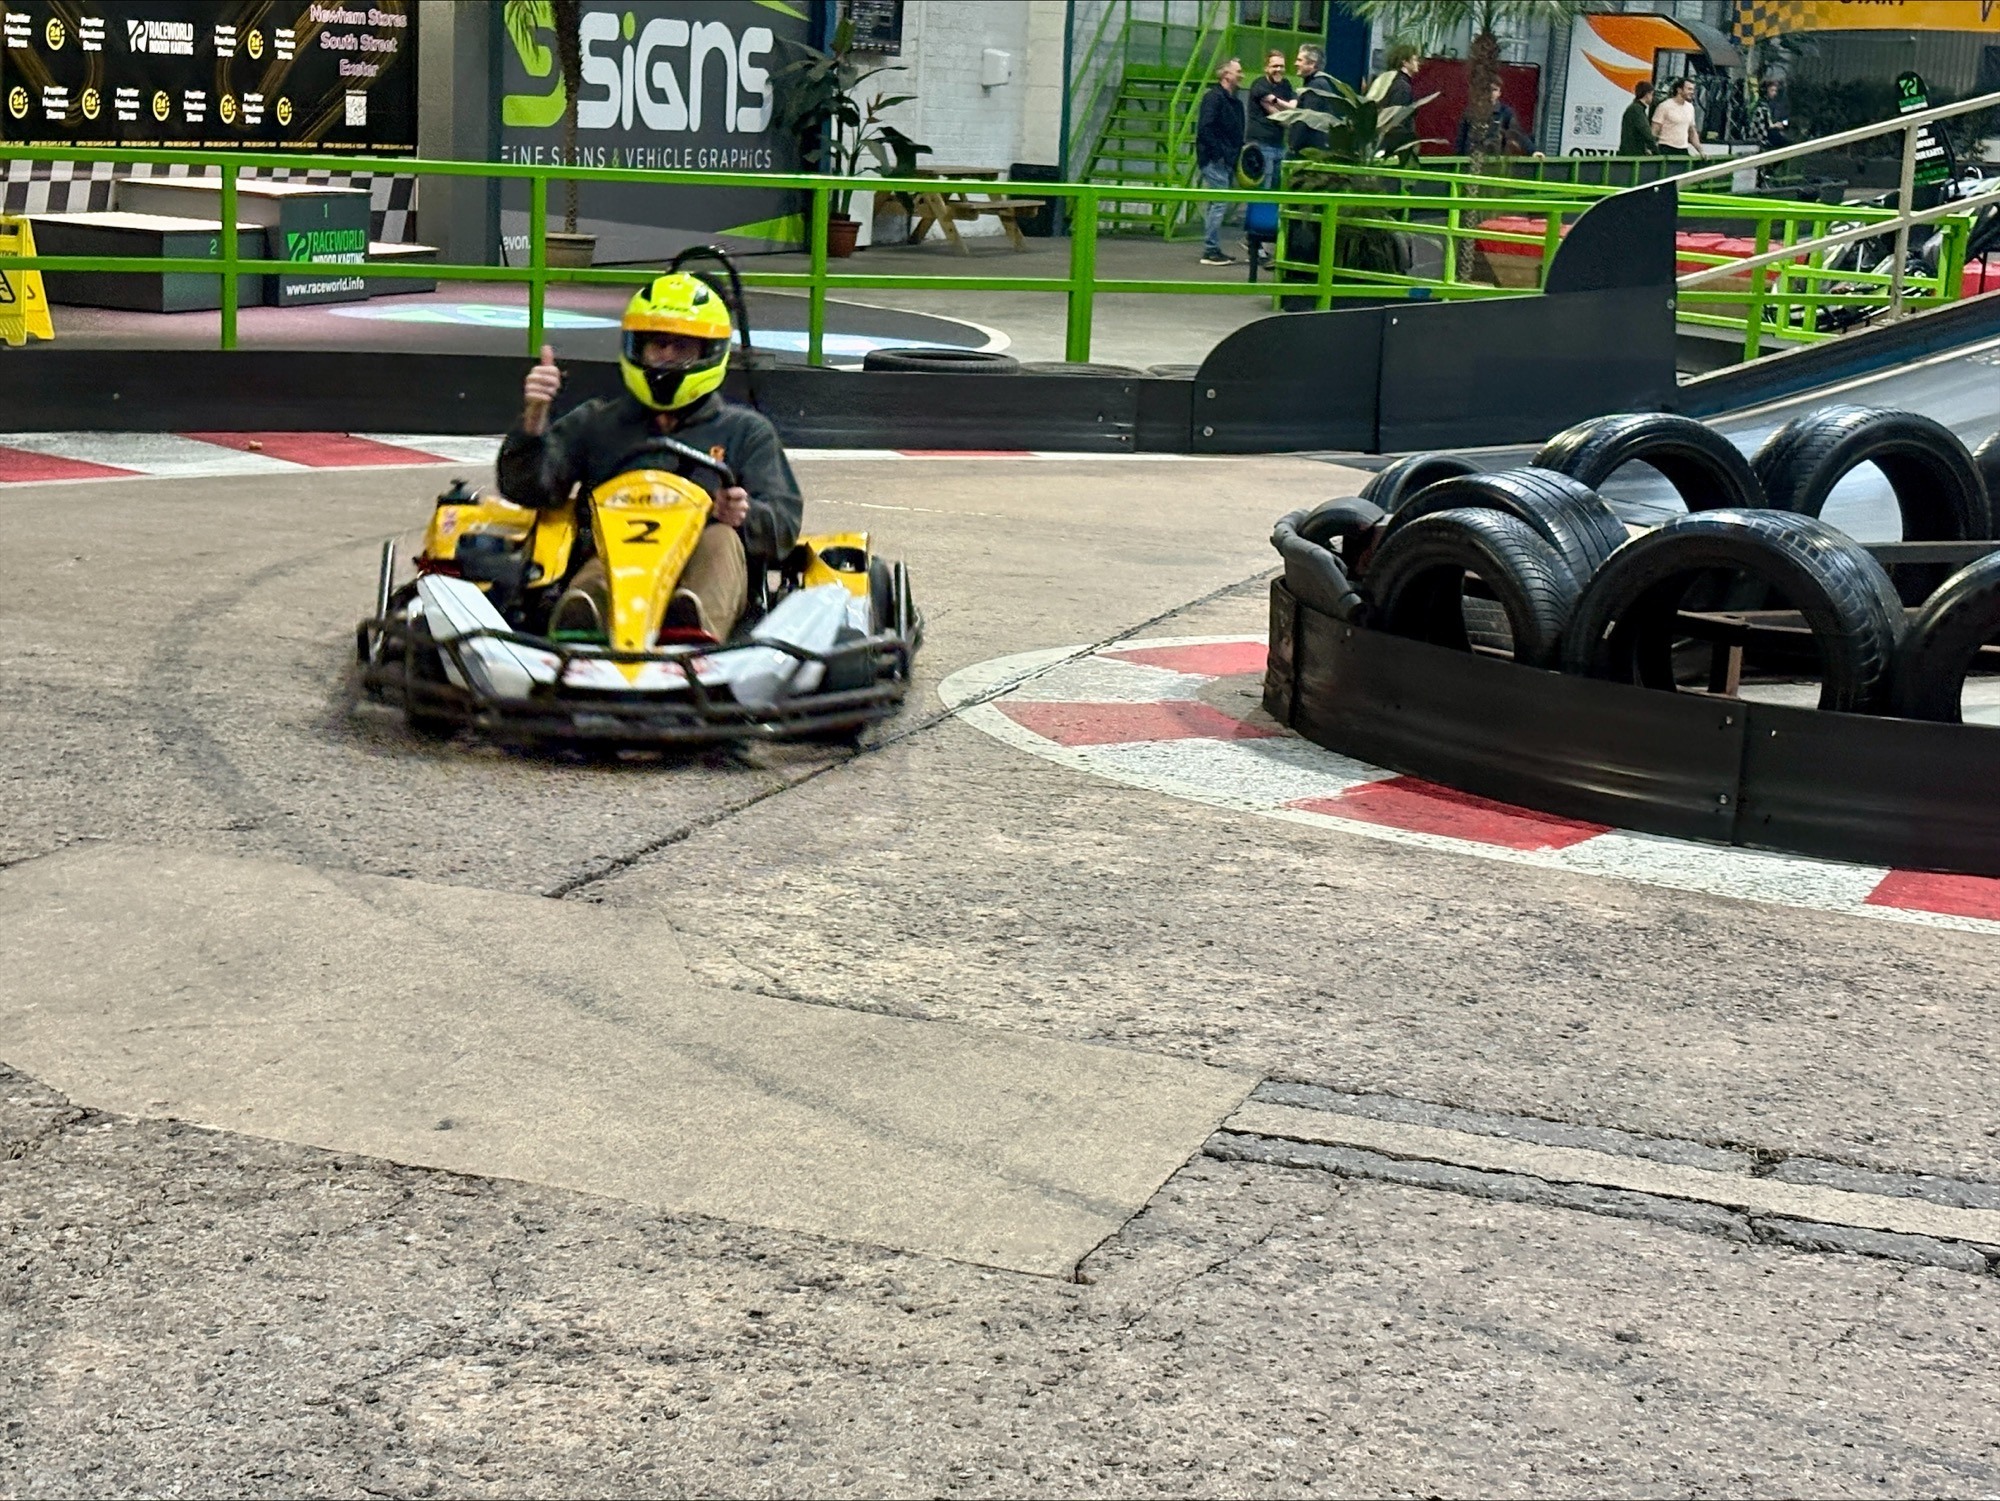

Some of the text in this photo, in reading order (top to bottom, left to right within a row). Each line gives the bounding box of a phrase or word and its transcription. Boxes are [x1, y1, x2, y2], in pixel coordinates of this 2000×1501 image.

[310, 4, 408, 28] Newham Stores
[149, 21, 194, 41] RACEWORLD
[320, 31, 398, 52] South Street
[340, 59, 379, 77] Exeter
[612, 148, 620, 168] &
[323, 203, 328, 218] 1
[209, 238, 218, 255] 2
[313, 230, 365, 252] RACEWORLD
[286, 277, 365, 296] www.raceworld.info
[622, 520, 661, 544] 2
